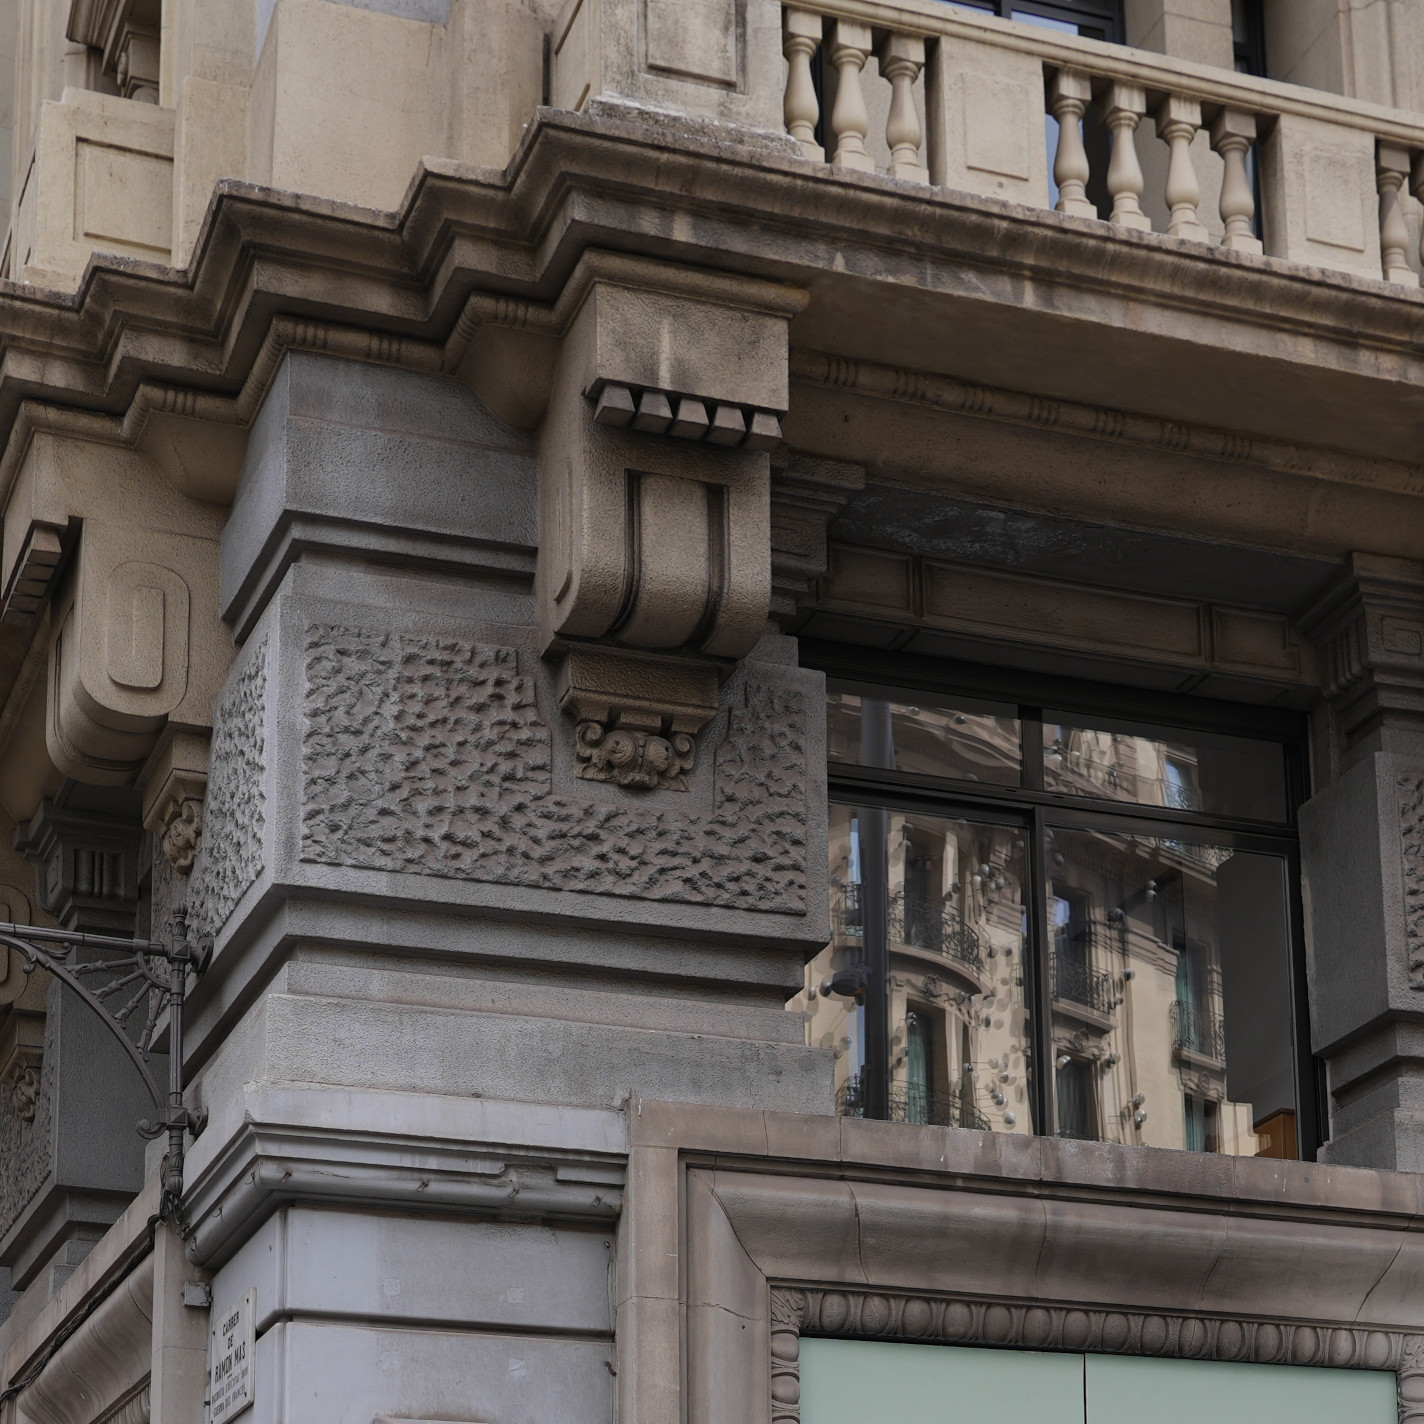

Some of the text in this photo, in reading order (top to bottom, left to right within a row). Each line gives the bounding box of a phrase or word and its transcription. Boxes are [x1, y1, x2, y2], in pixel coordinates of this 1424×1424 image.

[223, 1311, 239, 1337] CARRER
[228, 1334, 233, 1350] DE
[215, 1341, 246, 1384] RAMON MAS
